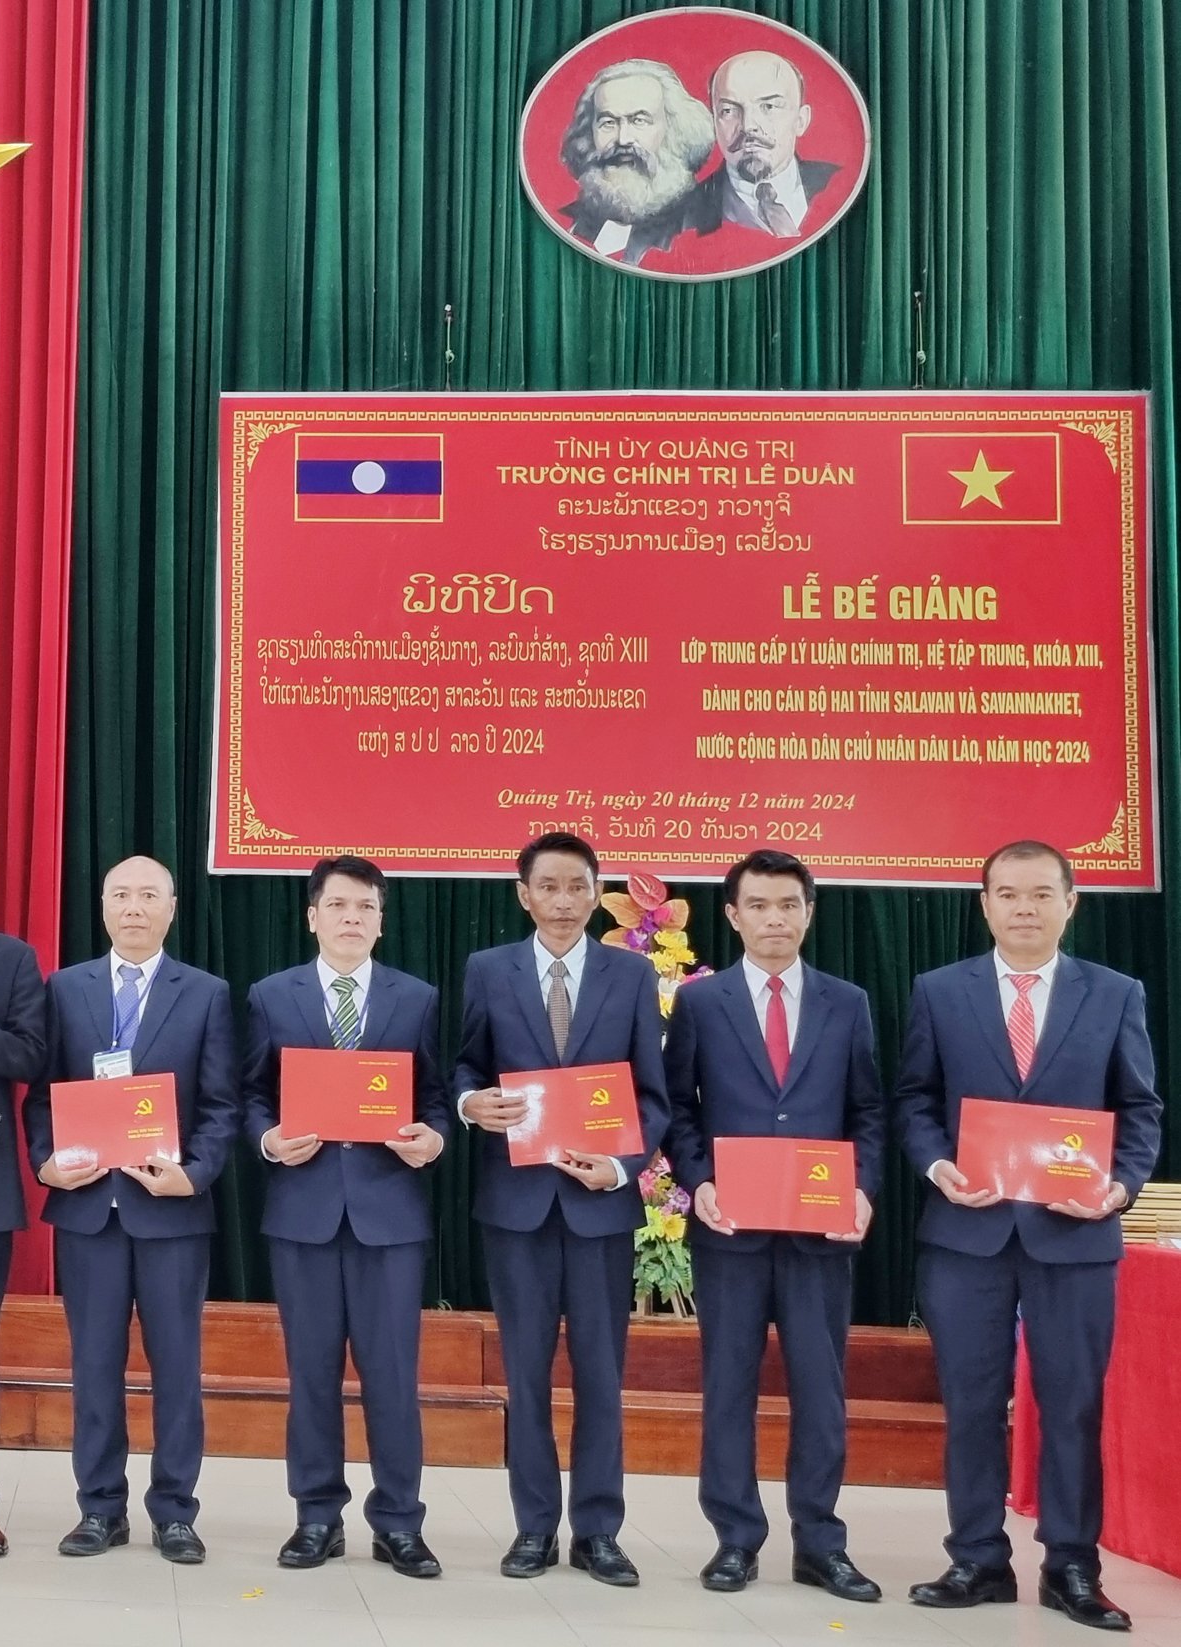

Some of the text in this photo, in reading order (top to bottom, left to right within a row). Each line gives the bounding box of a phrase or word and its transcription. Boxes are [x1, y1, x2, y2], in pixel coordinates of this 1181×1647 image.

[554, 436, 794, 462] TỈNH ỦY QUẢNG TRỊ
[495, 462, 855, 489] TRƯỜNG CHÍNH TRỊ LÊ DUẨN
[783, 572, 999, 621] LỄ BẾ GIẢNG
[619, 636, 648, 663] XIII
[680, 633, 1104, 671] LỚP TRUNG CẤP LÝ LUẬN CHÍNH TRỊ, HỆ TẬP TRUNG, KHÓA XIII,
[702, 682, 1083, 718] DÀNH CHO CÁN BỘ HAI TỈNH SALAVAN VÀ SAVANNAKHET,
[501, 728, 545, 755] 2024
[696, 730, 1091, 768] NƯỚC CỘNG HÒA DÂN CHỦ NHÂN DÂN LÀO, NĂM HỌC 2024
[497, 788, 856, 812] Quảng Trị, ngày 20 tháng 12 năm 2024
[664, 819, 692, 839] 20
[766, 821, 823, 841] 2024
